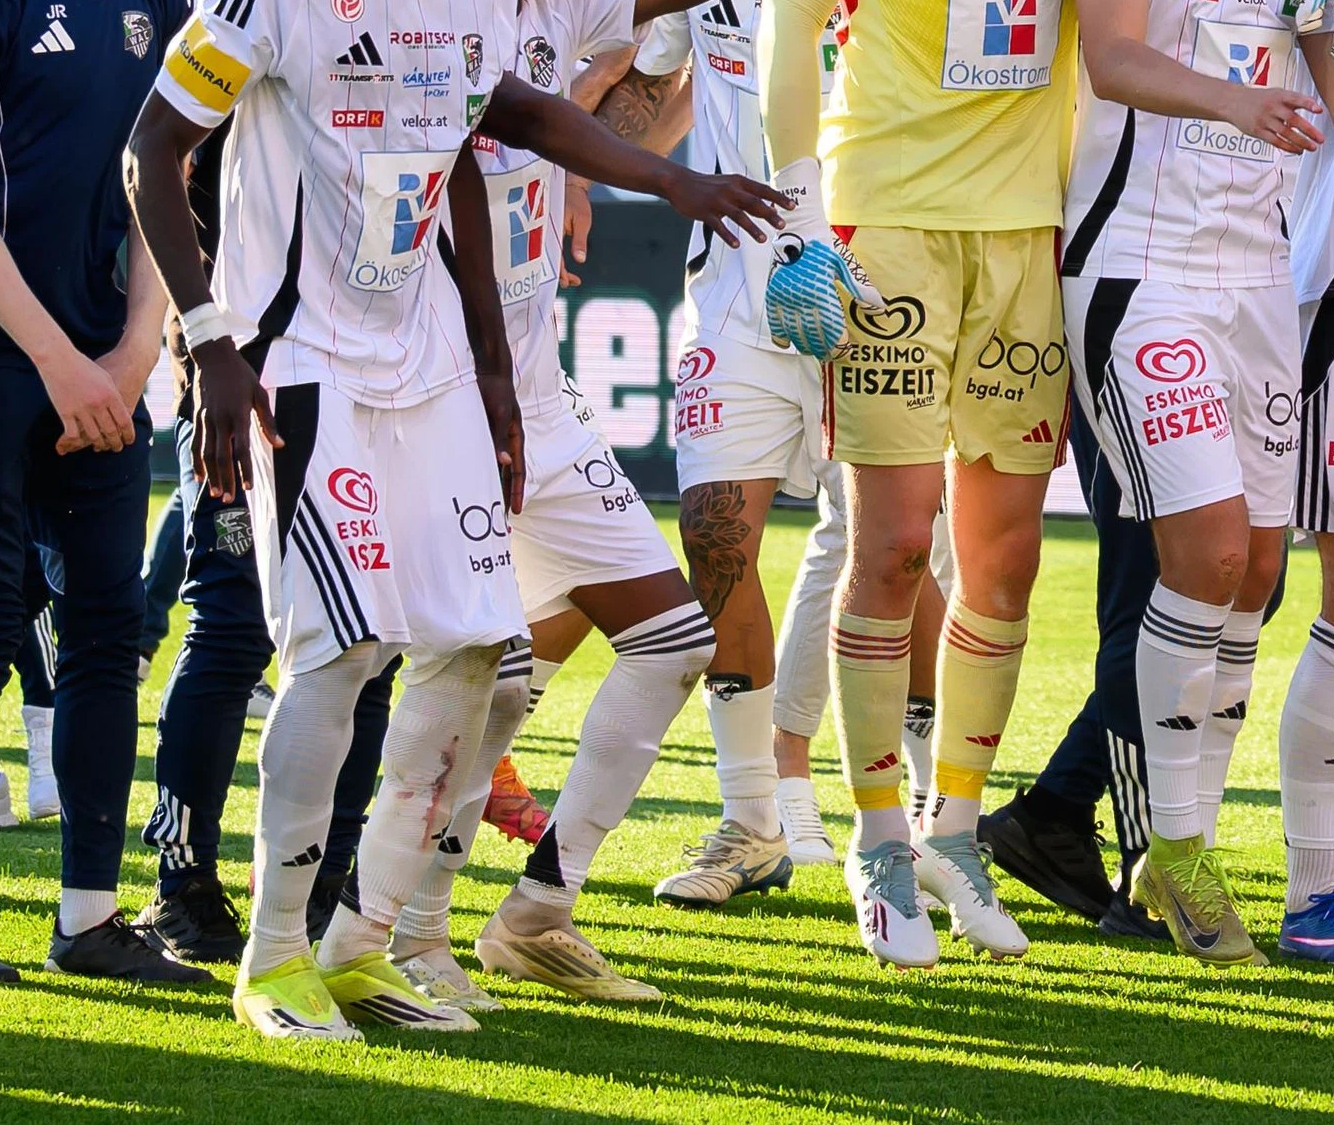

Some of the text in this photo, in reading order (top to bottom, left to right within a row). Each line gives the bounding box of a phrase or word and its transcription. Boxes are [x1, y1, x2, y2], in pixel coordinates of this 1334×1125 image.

[46, 4, 68, 20] JR
[129, 30, 150, 46] WAC
[389, 31, 456, 45] ROBITSCH
[178, 39, 235, 97] ADMIRAL
[709, 55, 731, 72] ORF
[947, 59, 1049, 87] Ökostrom
[334, 112, 382, 125] ORF K
[401, 114, 448, 128] velox.at
[849, 345, 926, 364] ESKIMO
[841, 367, 935, 396] EISZEIT
[966, 377, 1026, 403] bgd.at
[1145, 384, 1216, 413] ESKIMO
